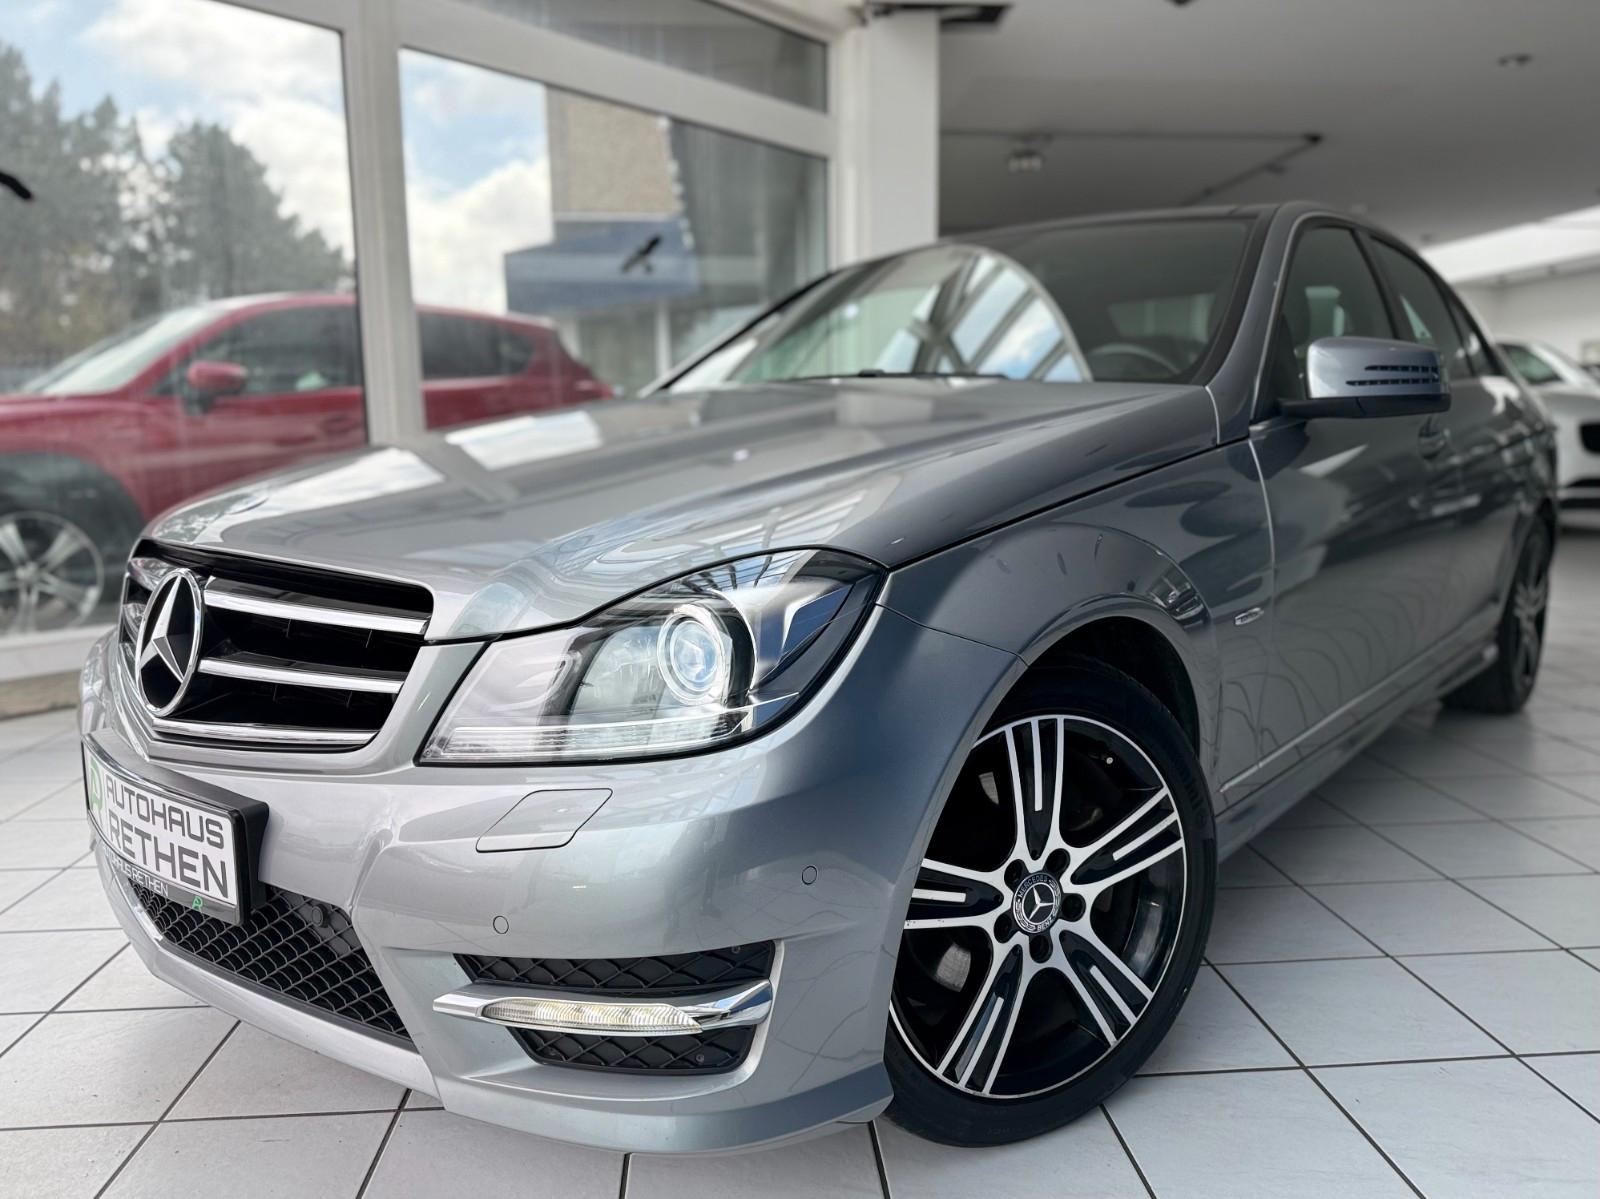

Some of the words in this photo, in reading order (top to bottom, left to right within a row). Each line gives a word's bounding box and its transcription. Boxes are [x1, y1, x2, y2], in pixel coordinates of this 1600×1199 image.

[106, 775, 225, 850] AUTOHAUS
[108, 808, 229, 899] RETHEN
[132, 866, 169, 898] RETHEN
